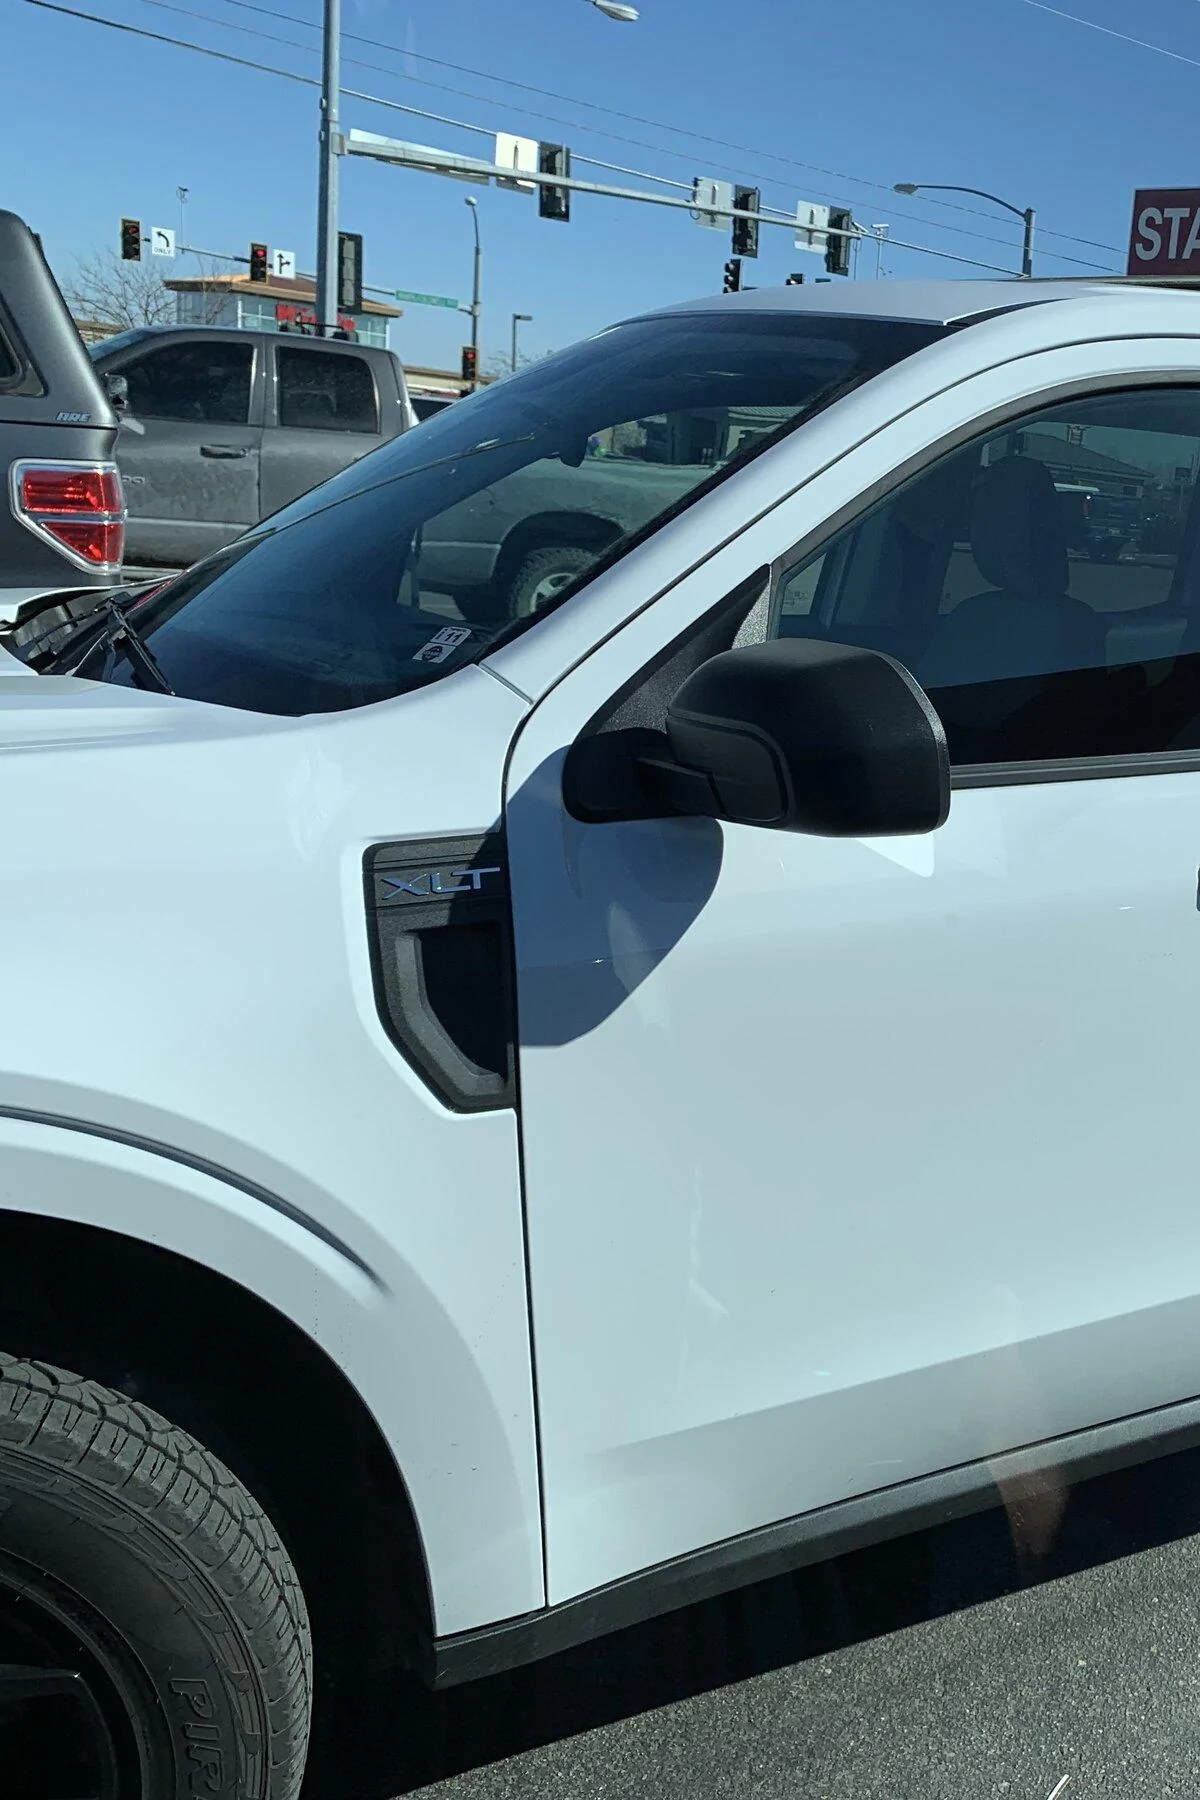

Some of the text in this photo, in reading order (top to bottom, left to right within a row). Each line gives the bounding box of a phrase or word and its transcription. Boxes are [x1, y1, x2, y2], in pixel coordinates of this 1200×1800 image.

[153, 247, 171, 255] ONLY
[381, 867, 500, 900] XLT
[168, 1678, 223, 1800] PIR
